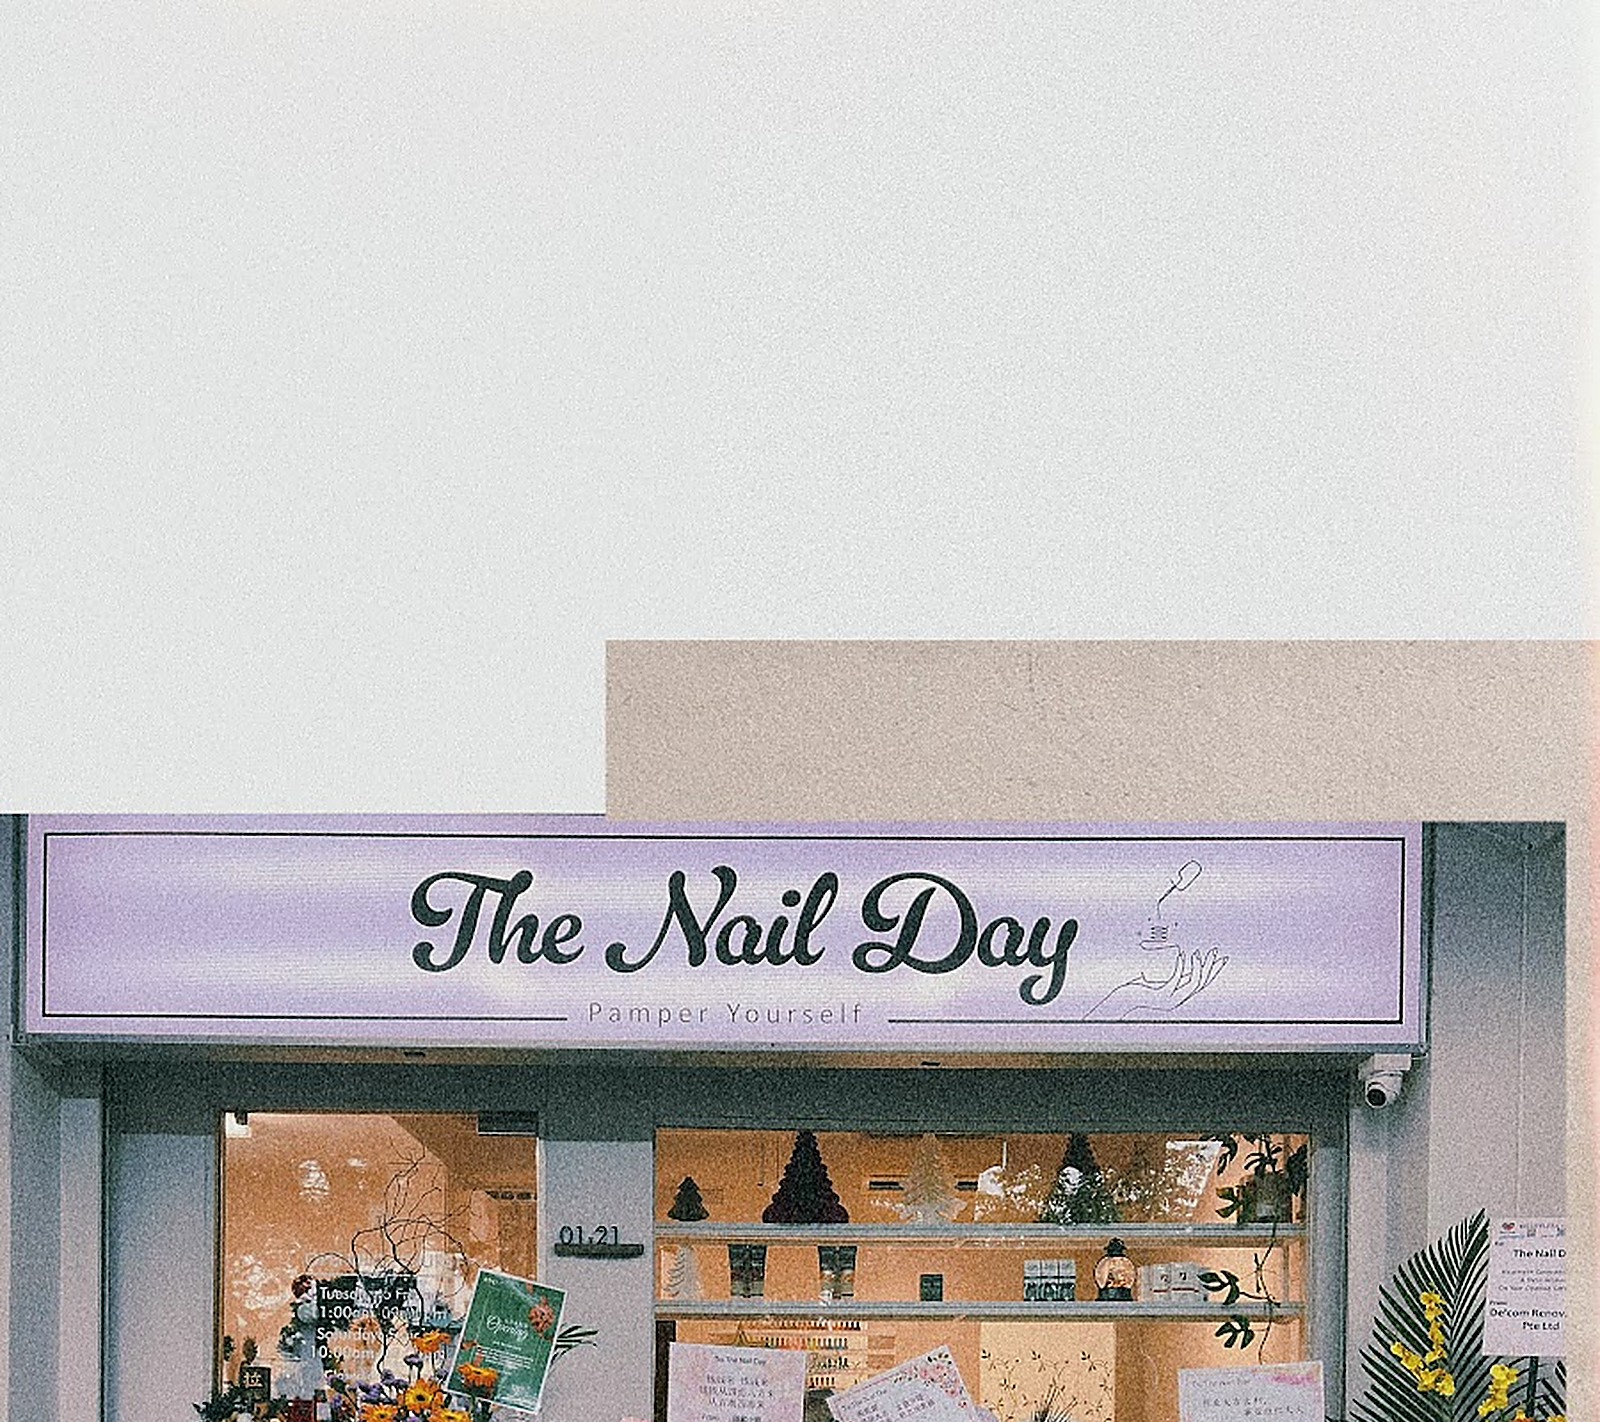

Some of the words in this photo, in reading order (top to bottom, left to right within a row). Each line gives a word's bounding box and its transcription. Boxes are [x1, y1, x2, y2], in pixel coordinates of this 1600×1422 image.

[411, 870, 585, 972] The
[605, 866, 839, 973] Nail
[852, 872, 1078, 1006] Day
[588, 1002, 708, 1027] Pamper
[727, 1003, 862, 1024] Yourself
[1513, 1249, 1533, 1258] The
[1535, 1249, 1556, 1258] Nail
[1531, 1308, 1567, 1318] Renov
[1542, 1321, 1560, 1331] Ltd
